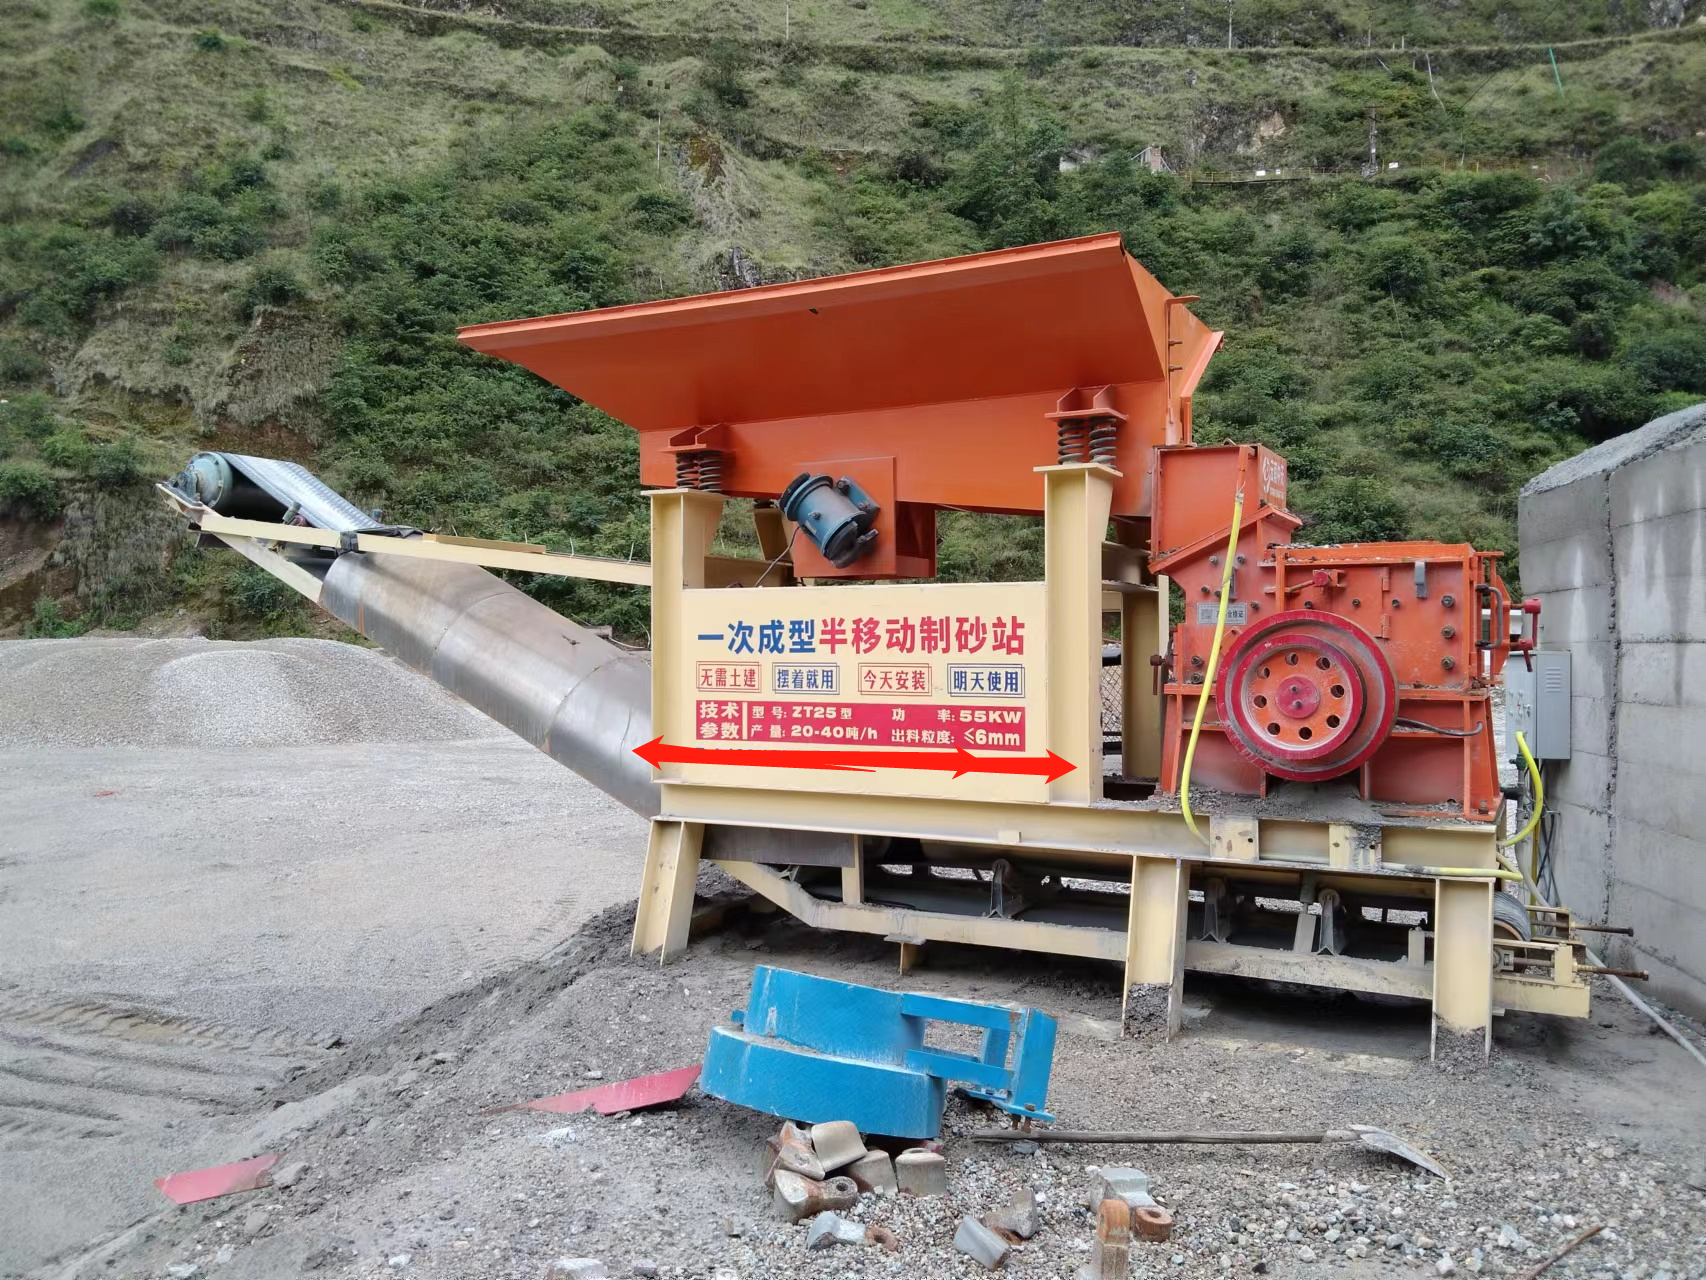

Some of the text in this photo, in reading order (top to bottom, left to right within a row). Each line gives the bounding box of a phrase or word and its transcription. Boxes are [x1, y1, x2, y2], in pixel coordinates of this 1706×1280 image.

[698, 616, 1025, 655] 一次成型半移动制砂站
[701, 668, 756, 688] 无需土建
[777, 669, 834, 689] 摆着就用
[863, 669, 926, 691] 今天安装
[953, 670, 1019, 692] 明天使用
[700, 702, 739, 719] 技术
[959, 709, 1022, 724] 55KW
[700, 722, 739, 740] 参数
